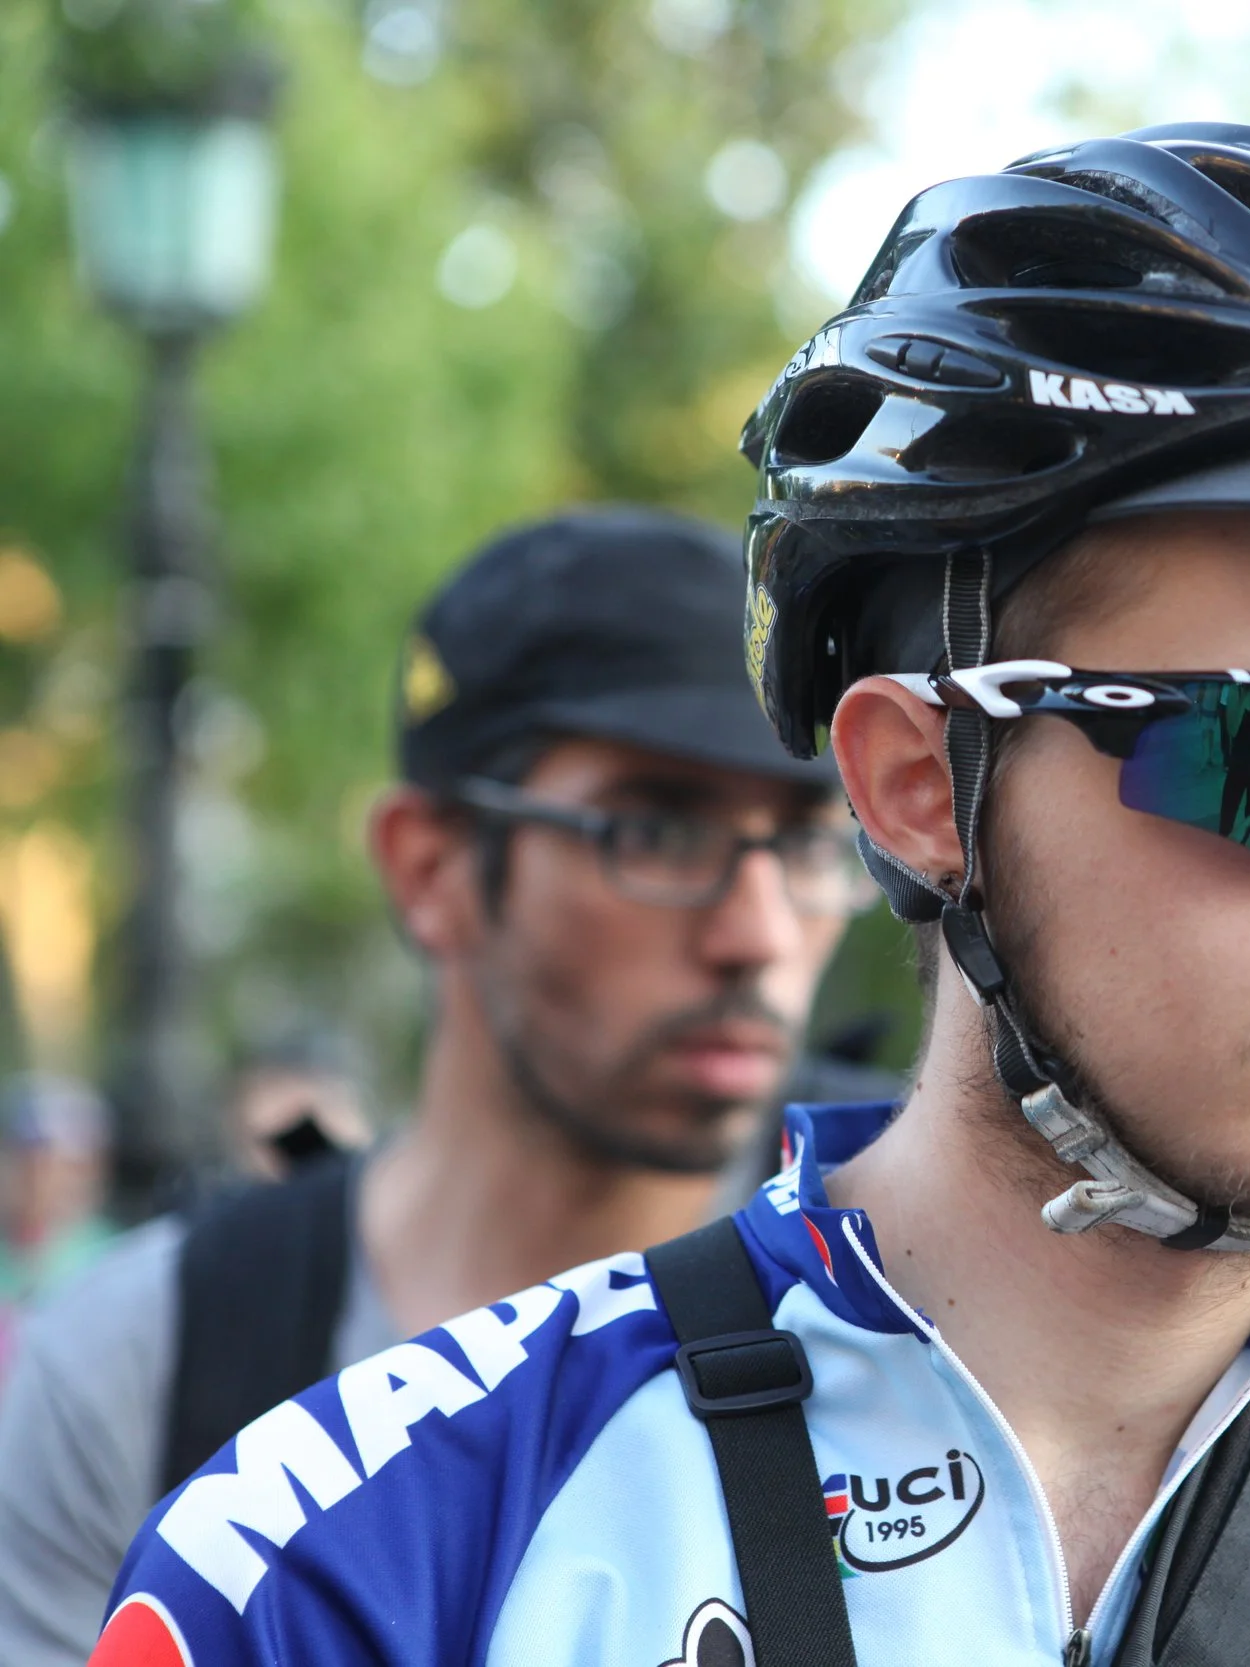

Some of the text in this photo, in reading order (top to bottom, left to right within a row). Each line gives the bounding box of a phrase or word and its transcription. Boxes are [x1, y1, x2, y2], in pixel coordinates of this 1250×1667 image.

[1029, 369, 1196, 415] KASK
[156, 1251, 658, 1616] MAPE
[865, 1515, 926, 1543] 1995
